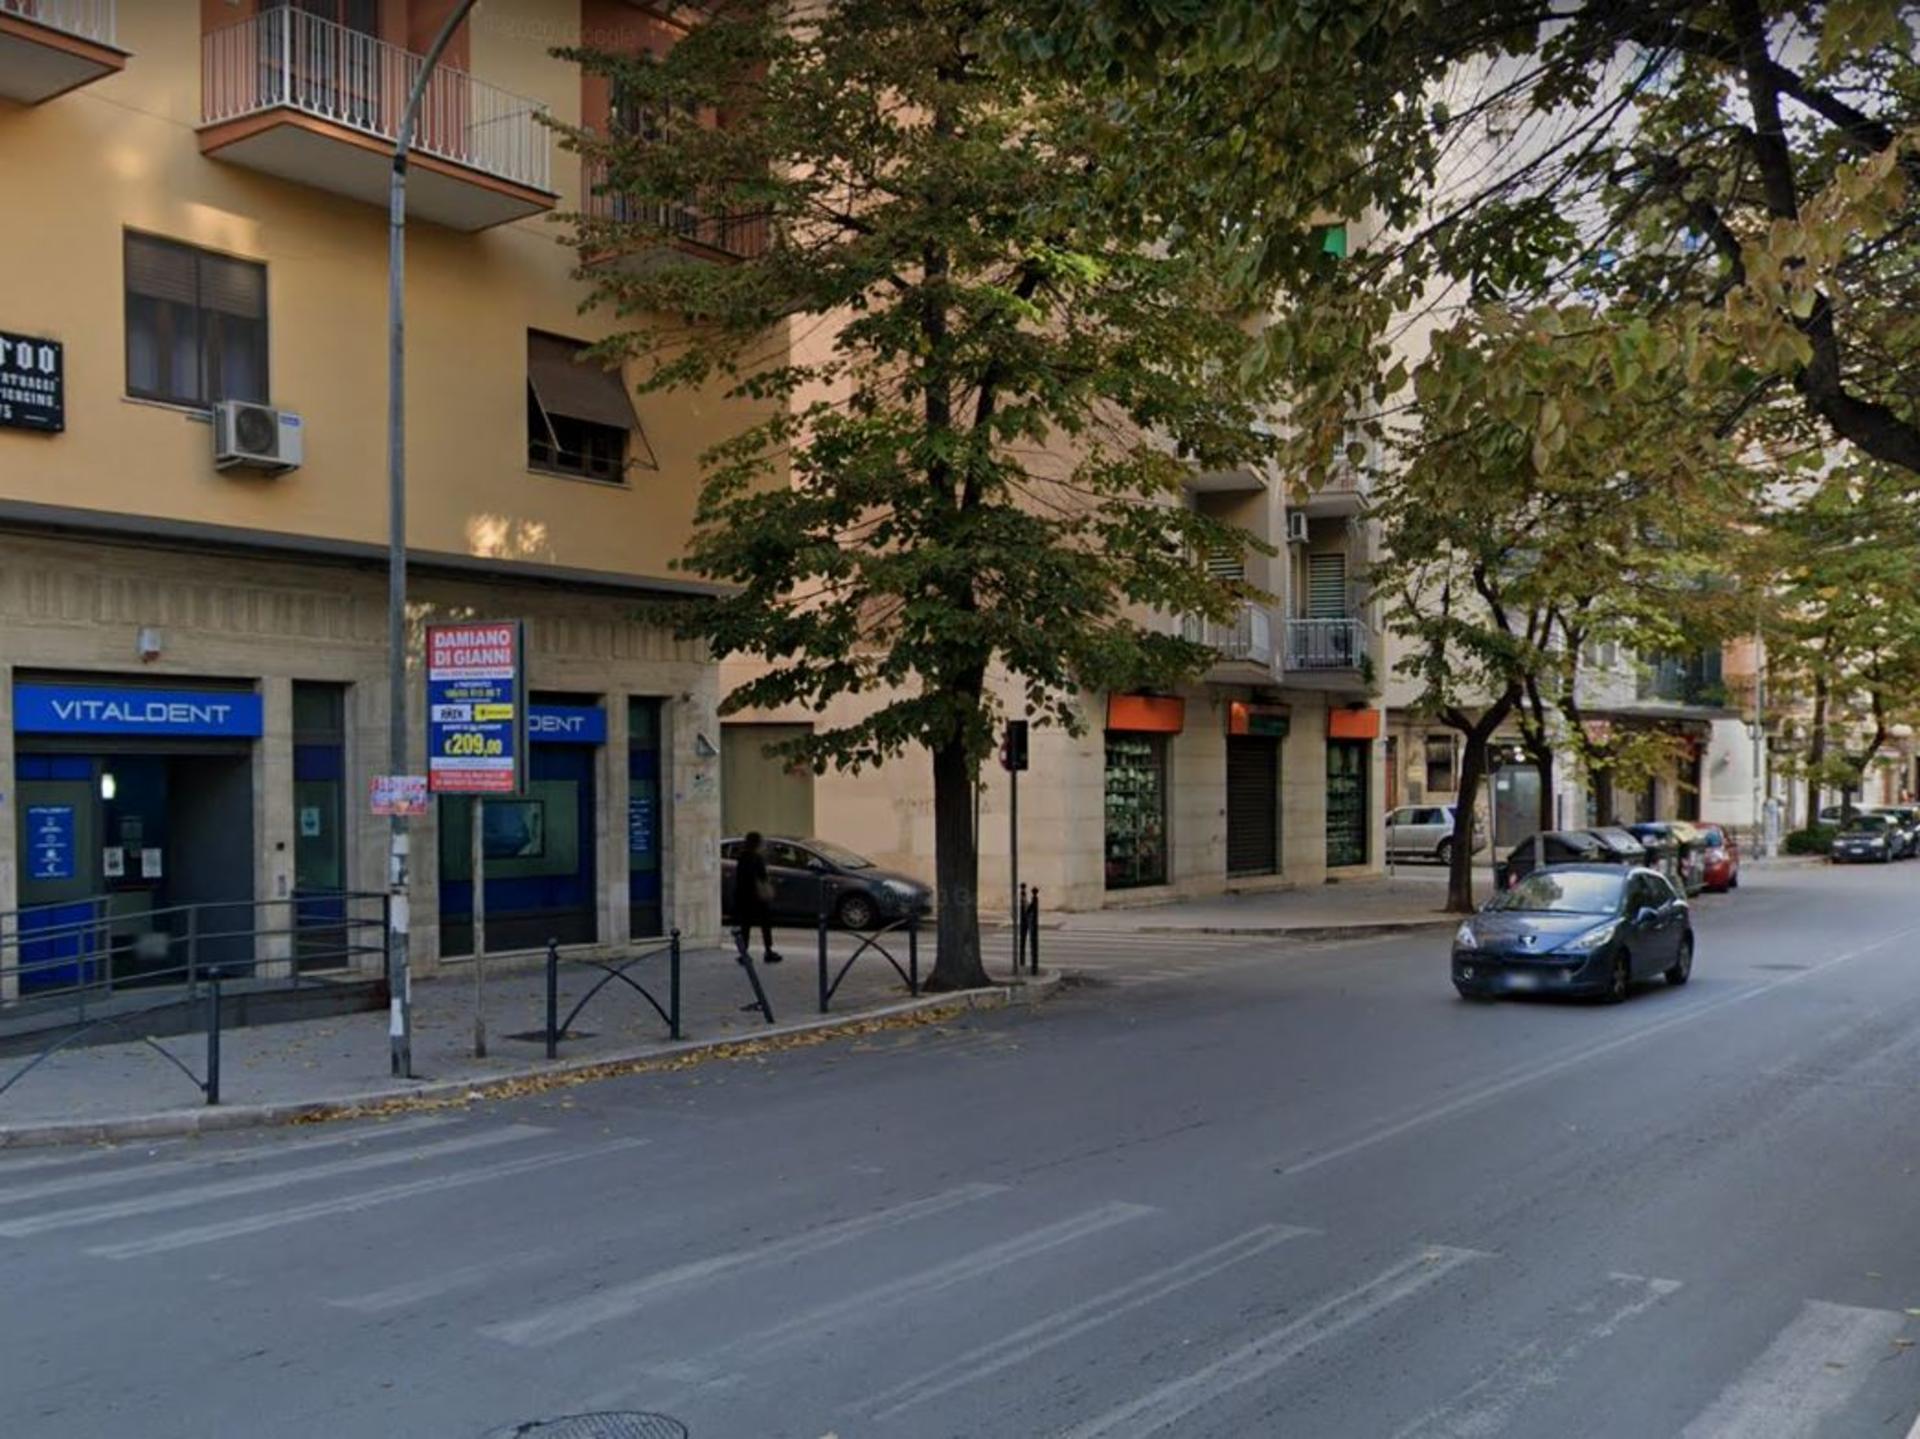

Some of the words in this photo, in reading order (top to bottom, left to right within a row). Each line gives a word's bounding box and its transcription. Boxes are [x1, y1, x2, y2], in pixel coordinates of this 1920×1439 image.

[0, 387, 54, 407] IERCING
[435, 630, 510, 648] DAMIANO
[435, 650, 451, 665] DI
[454, 649, 510, 665] GIANNI
[51, 700, 231, 724] VITALDENT
